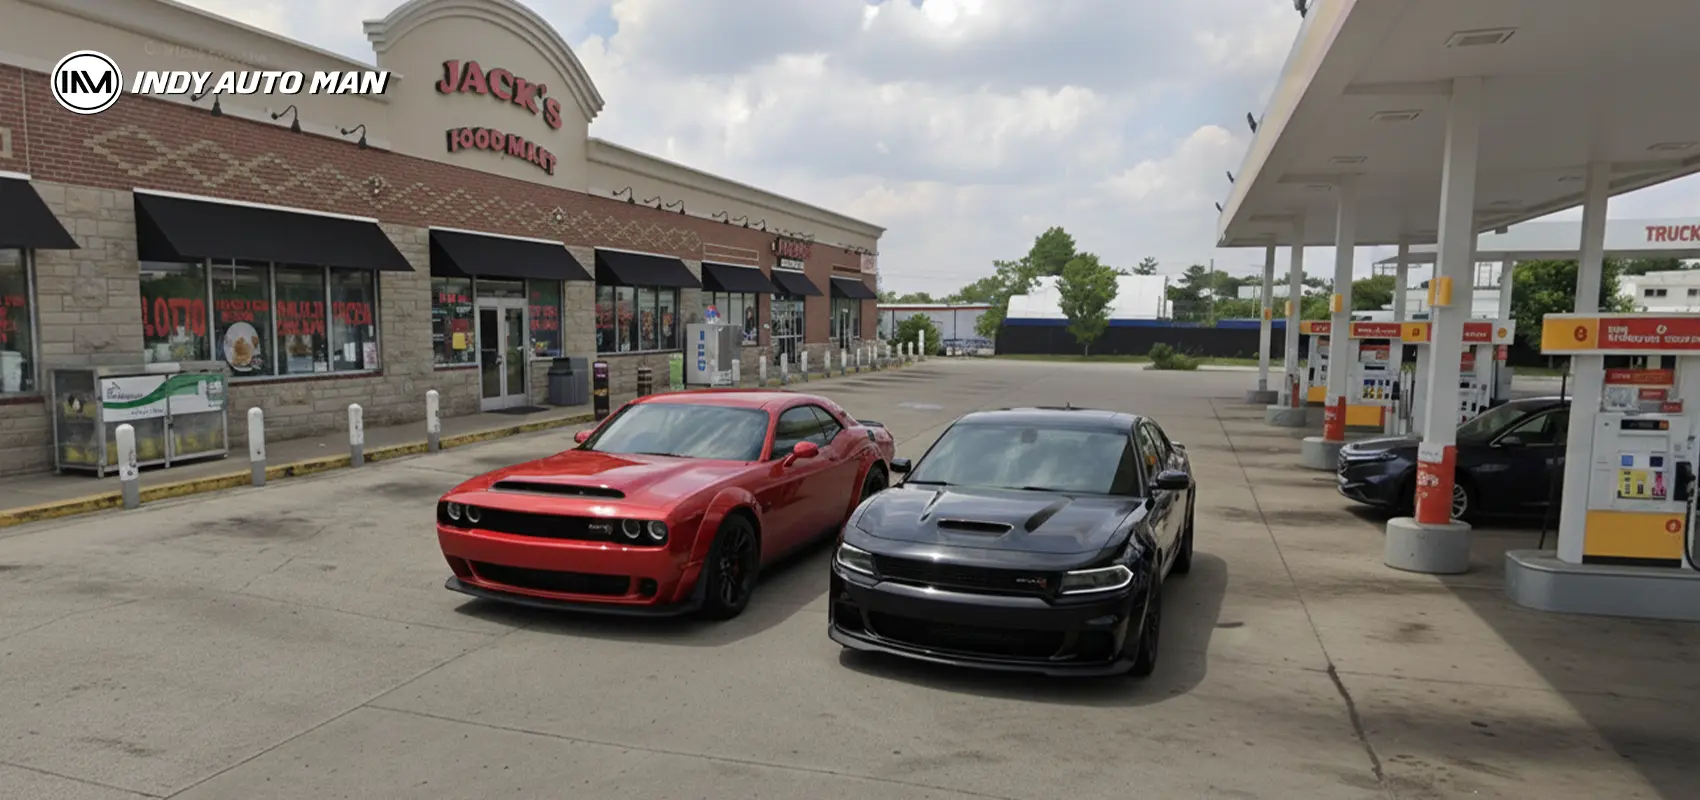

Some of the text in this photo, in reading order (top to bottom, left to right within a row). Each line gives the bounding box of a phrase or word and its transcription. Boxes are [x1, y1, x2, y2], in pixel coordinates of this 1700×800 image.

[436, 60, 562, 129] JACK'S
[447, 127, 506, 152] FOOD
[1645, 224, 1700, 242] TRUCK
